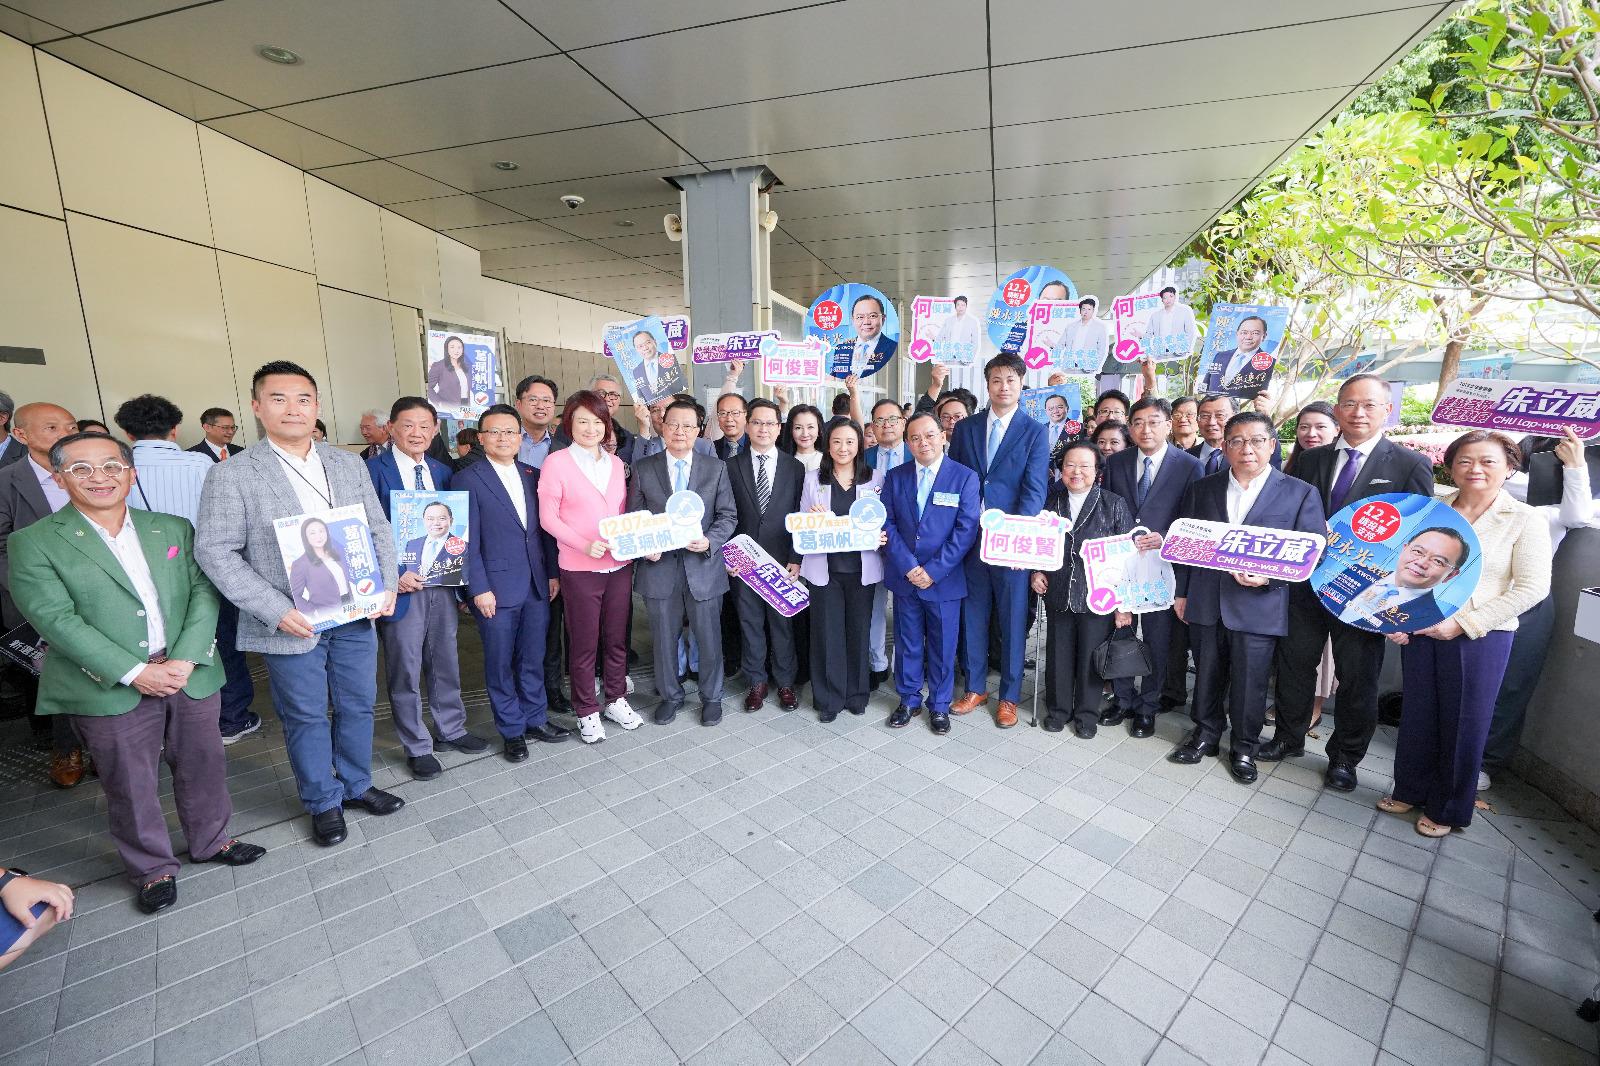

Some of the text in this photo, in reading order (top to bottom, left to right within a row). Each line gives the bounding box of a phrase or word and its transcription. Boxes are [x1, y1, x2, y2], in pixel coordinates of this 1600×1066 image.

[1007, 283, 1028, 294] 12.7
[817, 306, 838, 315] 12.7
[914, 298, 931, 318] 何
[1029, 303, 1053, 325] 何
[1113, 297, 1135, 320] 何
[727, 333, 780, 350] 朱立
[767, 358, 819, 377] 何俊賢
[476, 384, 487, 392] EQ
[1497, 387, 1600, 419] 朱立威
[1492, 416, 1517, 425] CHU
[789, 514, 826, 531] 12.07
[1363, 504, 1400, 527] 12.7
[601, 517, 641, 537] 12.07
[1356, 528, 1377, 542] 支持
[1357, 517, 1388, 536] 請投票
[615, 528, 674, 556] 葛珮帆
[798, 530, 854, 551] 葛珮帆
[989, 531, 1057, 557] 何俊賢
[1218, 529, 1313, 563] 朱立威
[1083, 540, 1106, 564] 何
[1217, 555, 1239, 565] CHU
[1281, 566, 1303, 577] Roy
[756, 562, 810, 607] 朱立威
